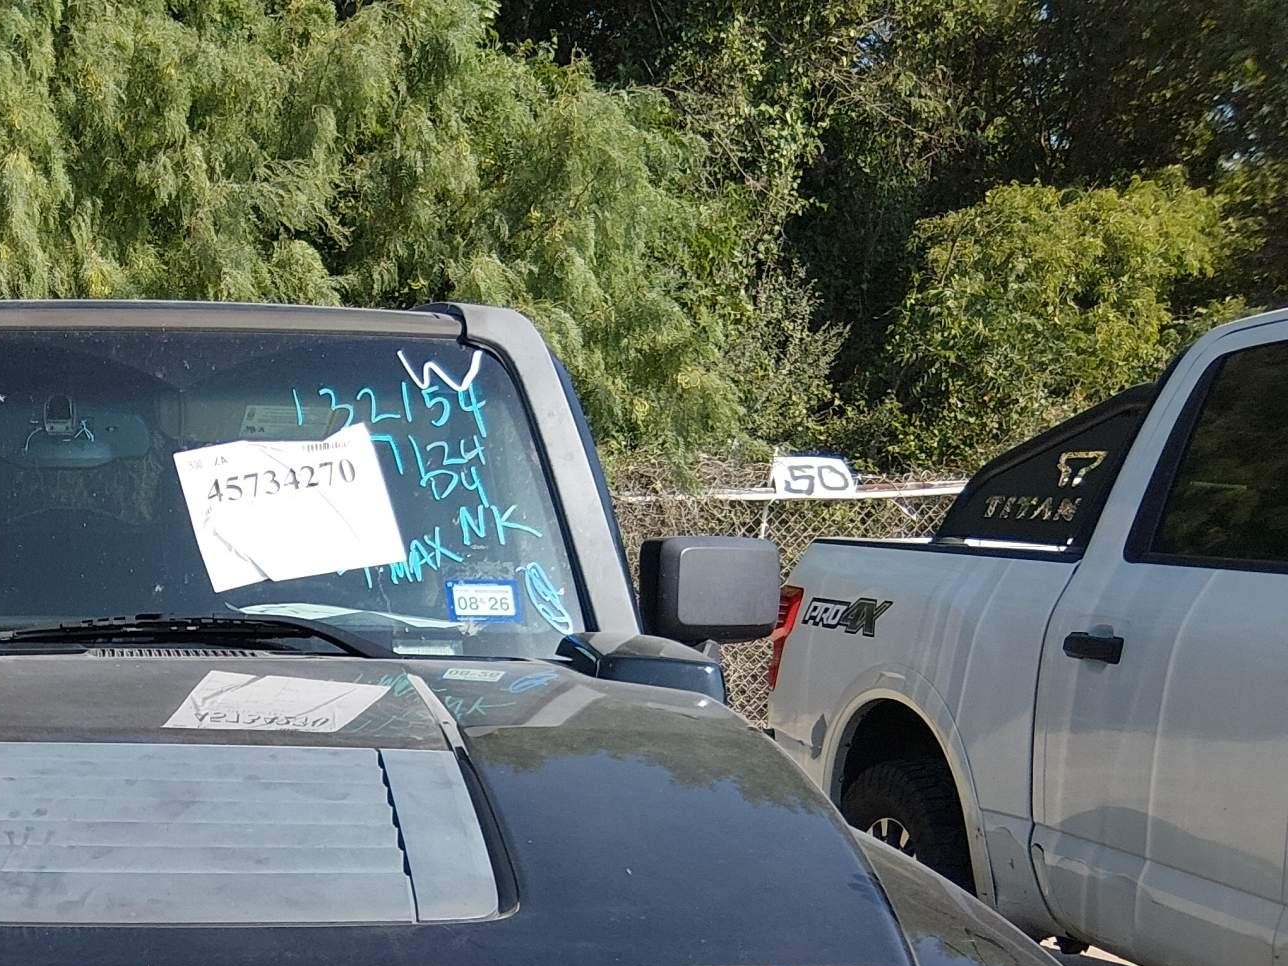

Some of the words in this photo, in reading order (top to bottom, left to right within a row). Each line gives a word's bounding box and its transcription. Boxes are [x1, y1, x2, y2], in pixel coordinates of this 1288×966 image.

[292, 380, 487, 438] 132154
[207, 458, 356, 503] 45734270
[783, 464, 850, 496] 50
[983, 495, 1082, 522] TITAN
[457, 595, 480, 611] 08
[488, 596, 510, 611] 26
